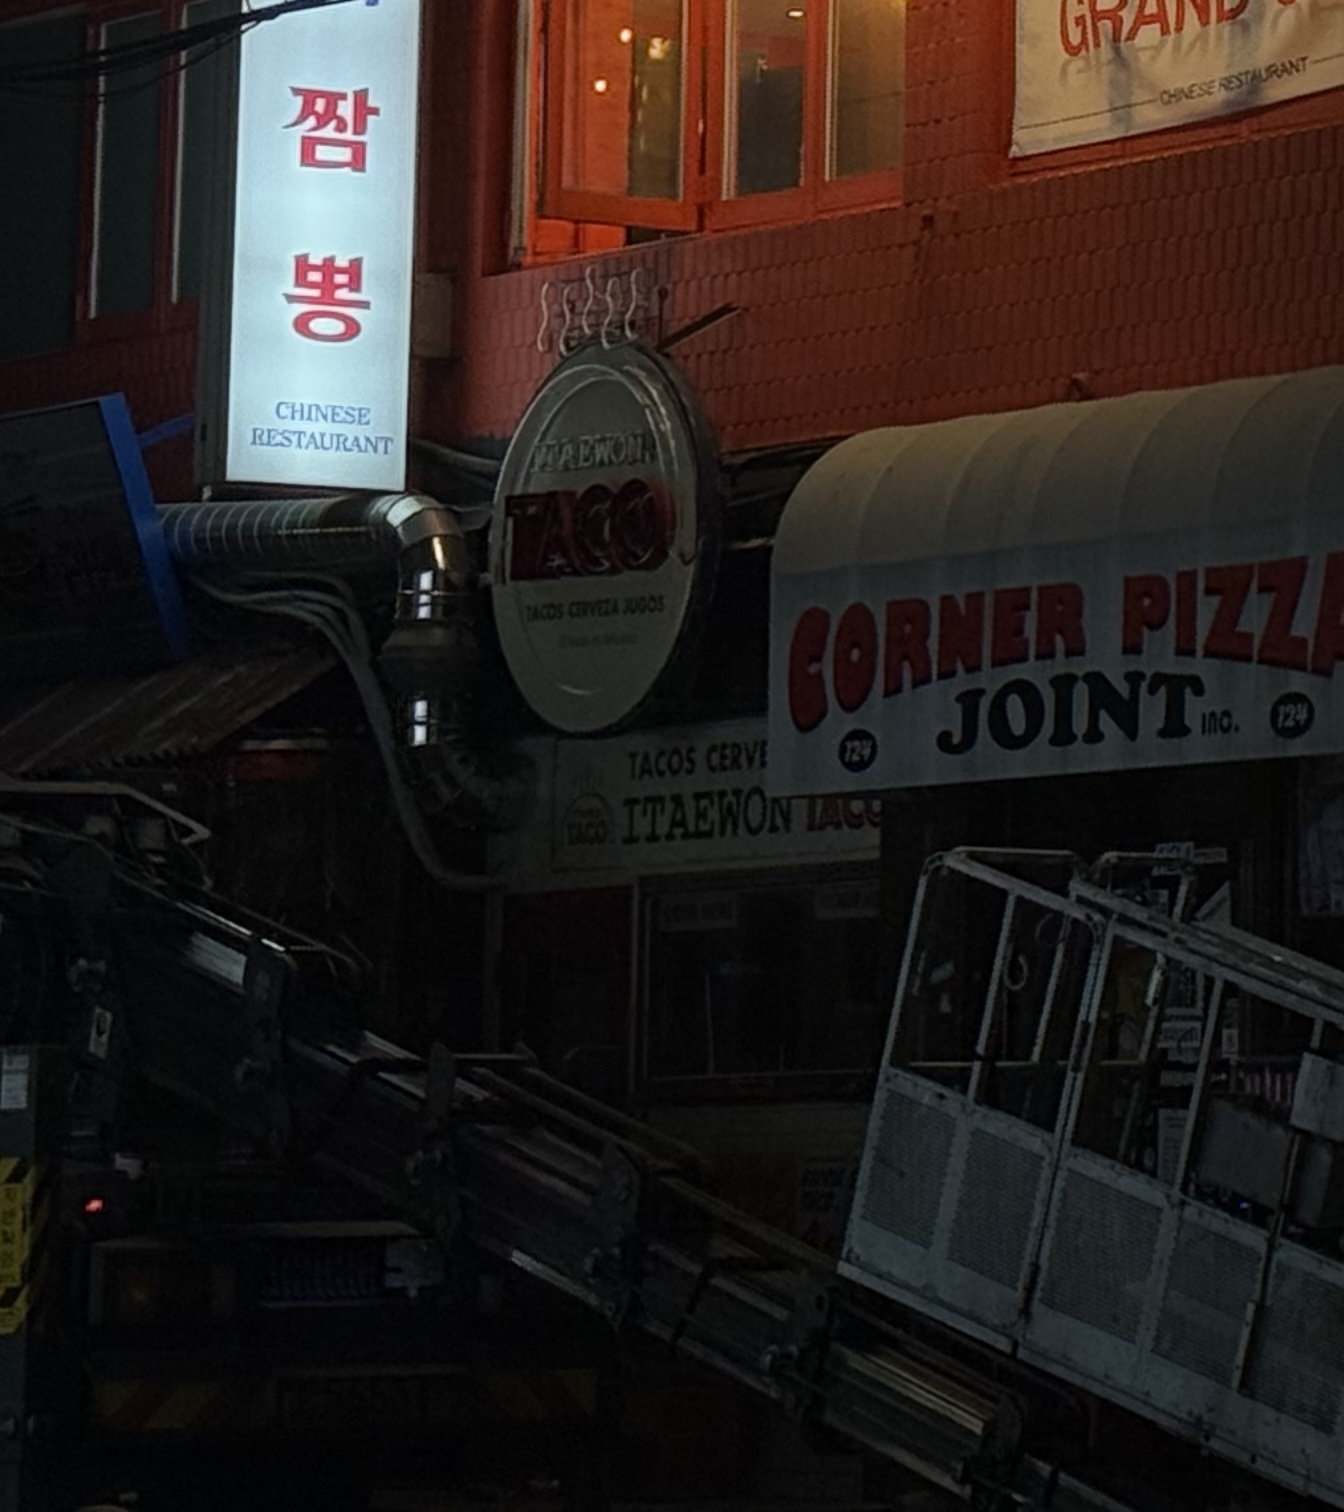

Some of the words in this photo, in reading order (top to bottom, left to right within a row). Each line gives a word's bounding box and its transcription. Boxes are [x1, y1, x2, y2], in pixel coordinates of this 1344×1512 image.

[1159, 78, 1217, 106] CHINESE
[1217, 56, 1308, 95] RESTAURANT
[275, 401, 371, 427] CHINESE
[250, 427, 394, 456] RESTAURANT
[526, 602, 565, 623] TACOS
[789, 582, 1087, 734] CORNER
[936, 670, 1205, 755] JOINT
[627, 746, 696, 781] TACOS
[621, 786, 793, 846] ITAEWON
